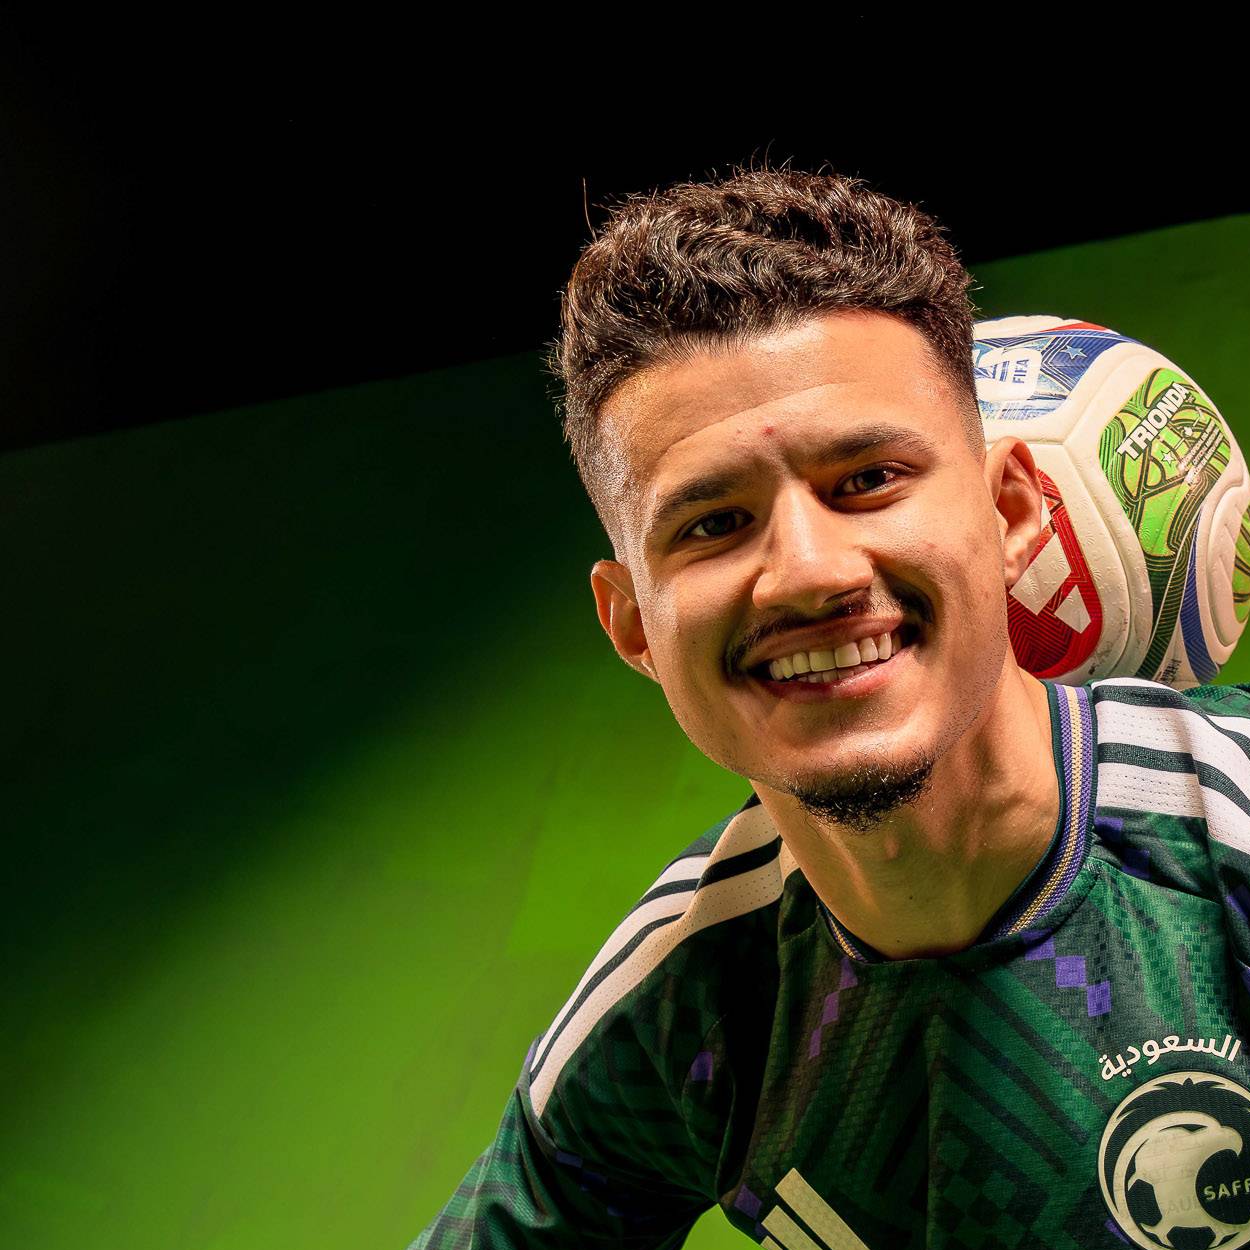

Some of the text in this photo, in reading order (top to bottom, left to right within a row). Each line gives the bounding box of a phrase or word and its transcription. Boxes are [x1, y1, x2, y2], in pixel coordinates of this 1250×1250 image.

[1012, 359, 1029, 384] FIFA
[1116, 381, 1190, 461] TRIONDA
[1098, 1034, 1242, 1082] السعودية
